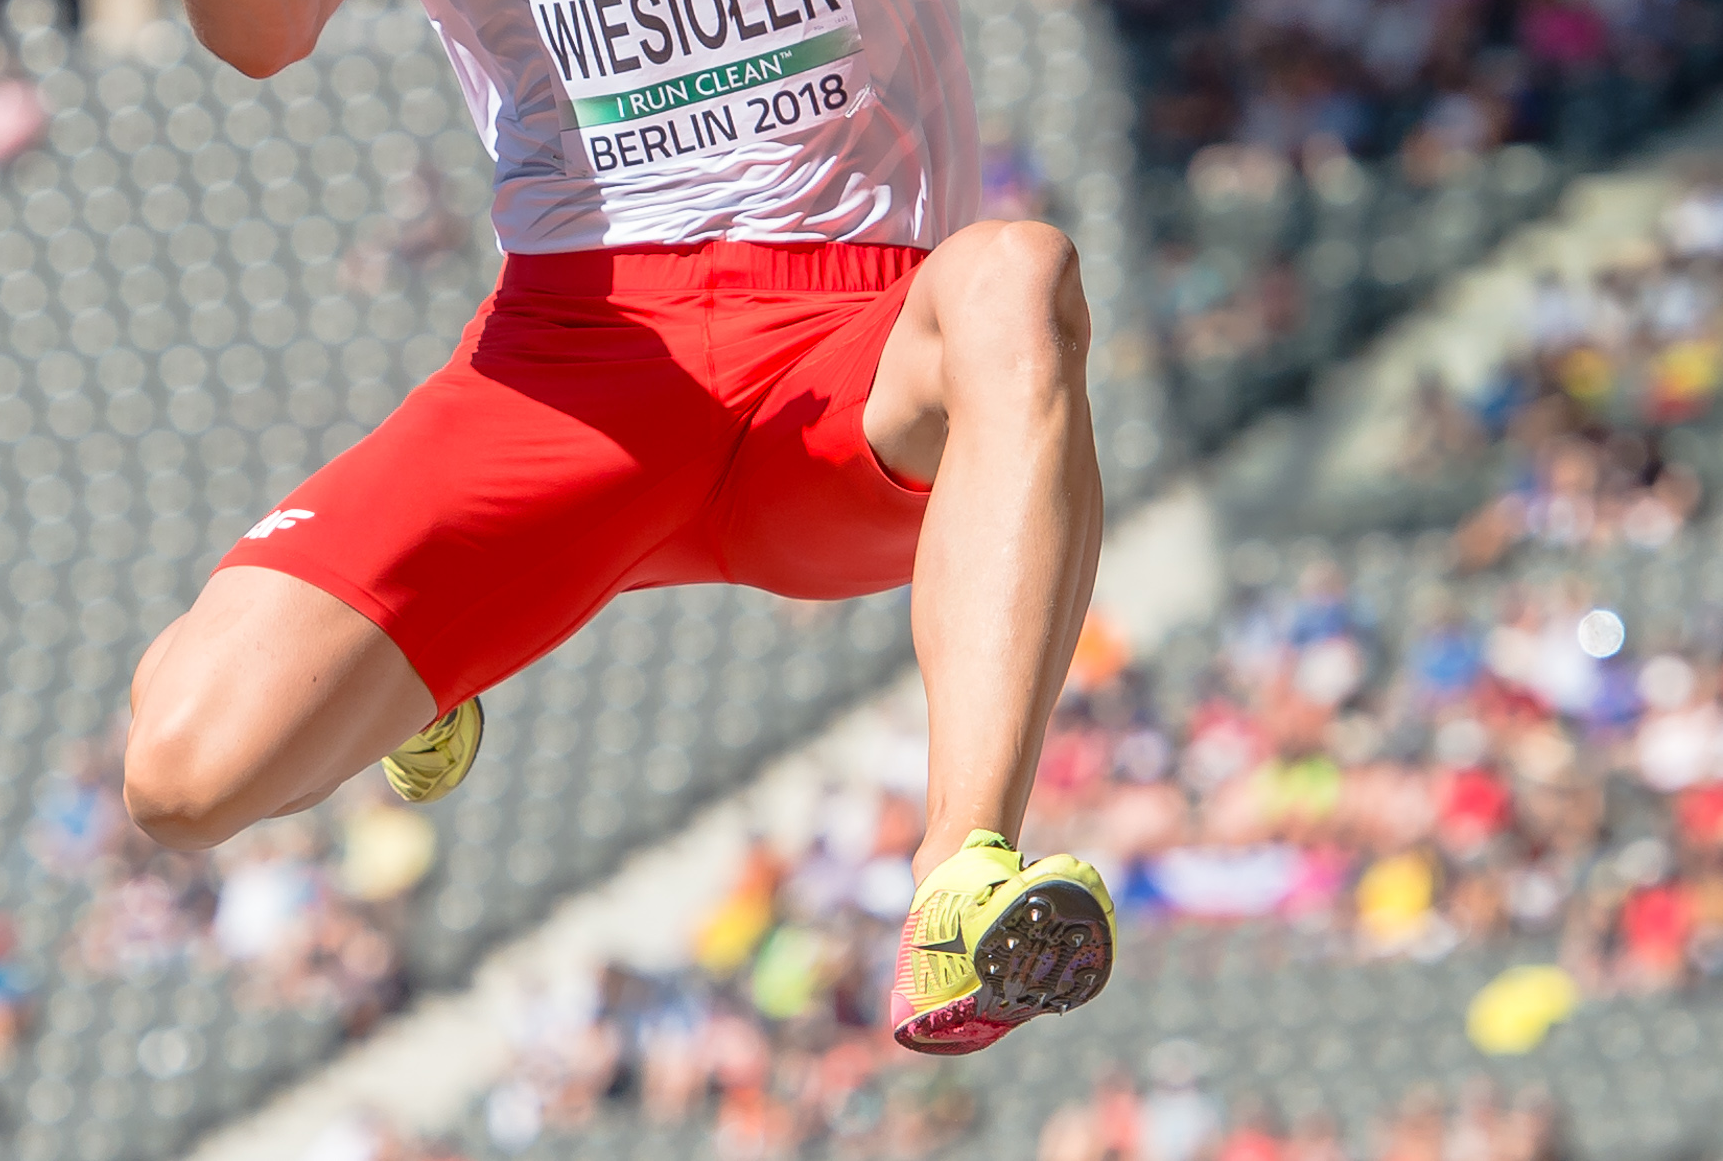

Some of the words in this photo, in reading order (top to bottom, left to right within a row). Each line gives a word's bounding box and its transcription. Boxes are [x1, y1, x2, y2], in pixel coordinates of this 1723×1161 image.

[589, 104, 738, 172] BERLIN
[746, 73, 848, 134] 2018
[616, 96, 626, 118] I
[629, 80, 688, 115] RUN
